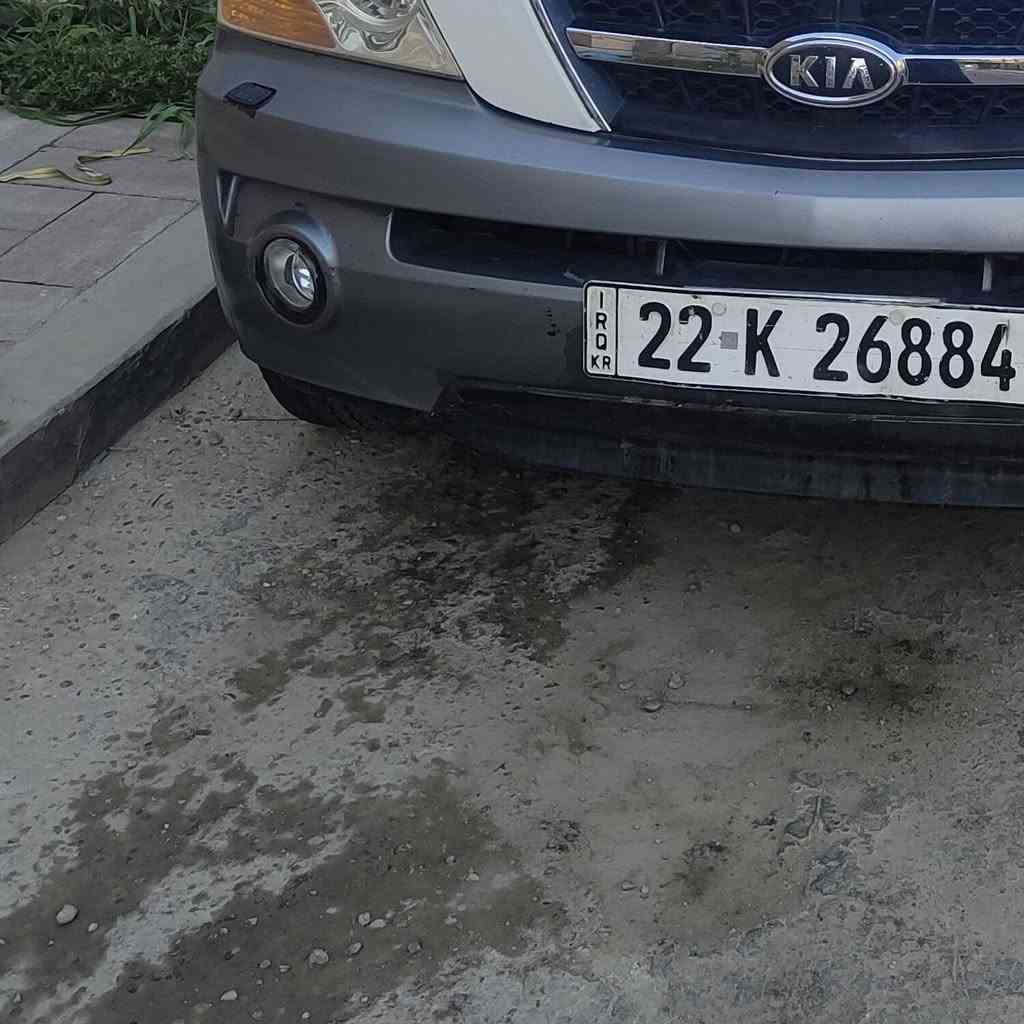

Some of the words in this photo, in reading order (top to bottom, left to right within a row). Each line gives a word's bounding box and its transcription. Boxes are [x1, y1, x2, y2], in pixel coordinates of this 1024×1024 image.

[788, 53, 875, 91] KIA
[595, 290, 608, 351] IRQ
[591, 354, 612, 370] KR
[637, 301, 713, 373] 22
[743, 307, 783, 377] K
[813, 313, 1016, 392] 26884
